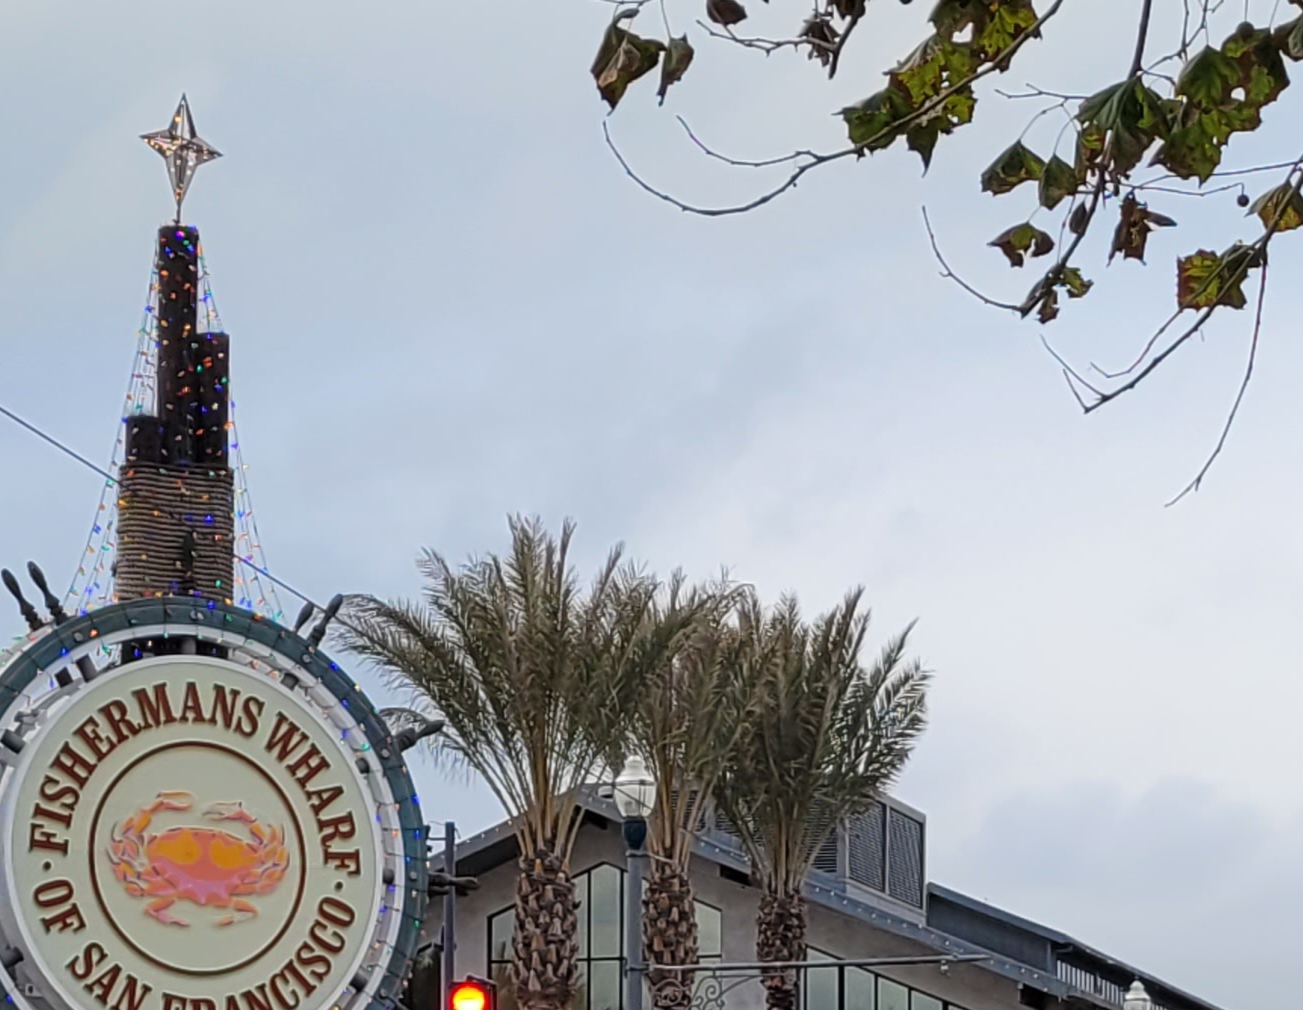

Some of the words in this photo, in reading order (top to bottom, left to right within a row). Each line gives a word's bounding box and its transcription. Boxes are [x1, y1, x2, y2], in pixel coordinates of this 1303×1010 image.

[29, 681, 265, 857] FISHERMANS
[265, 711, 361, 876] WHARF
[33, 879, 86, 935] OF
